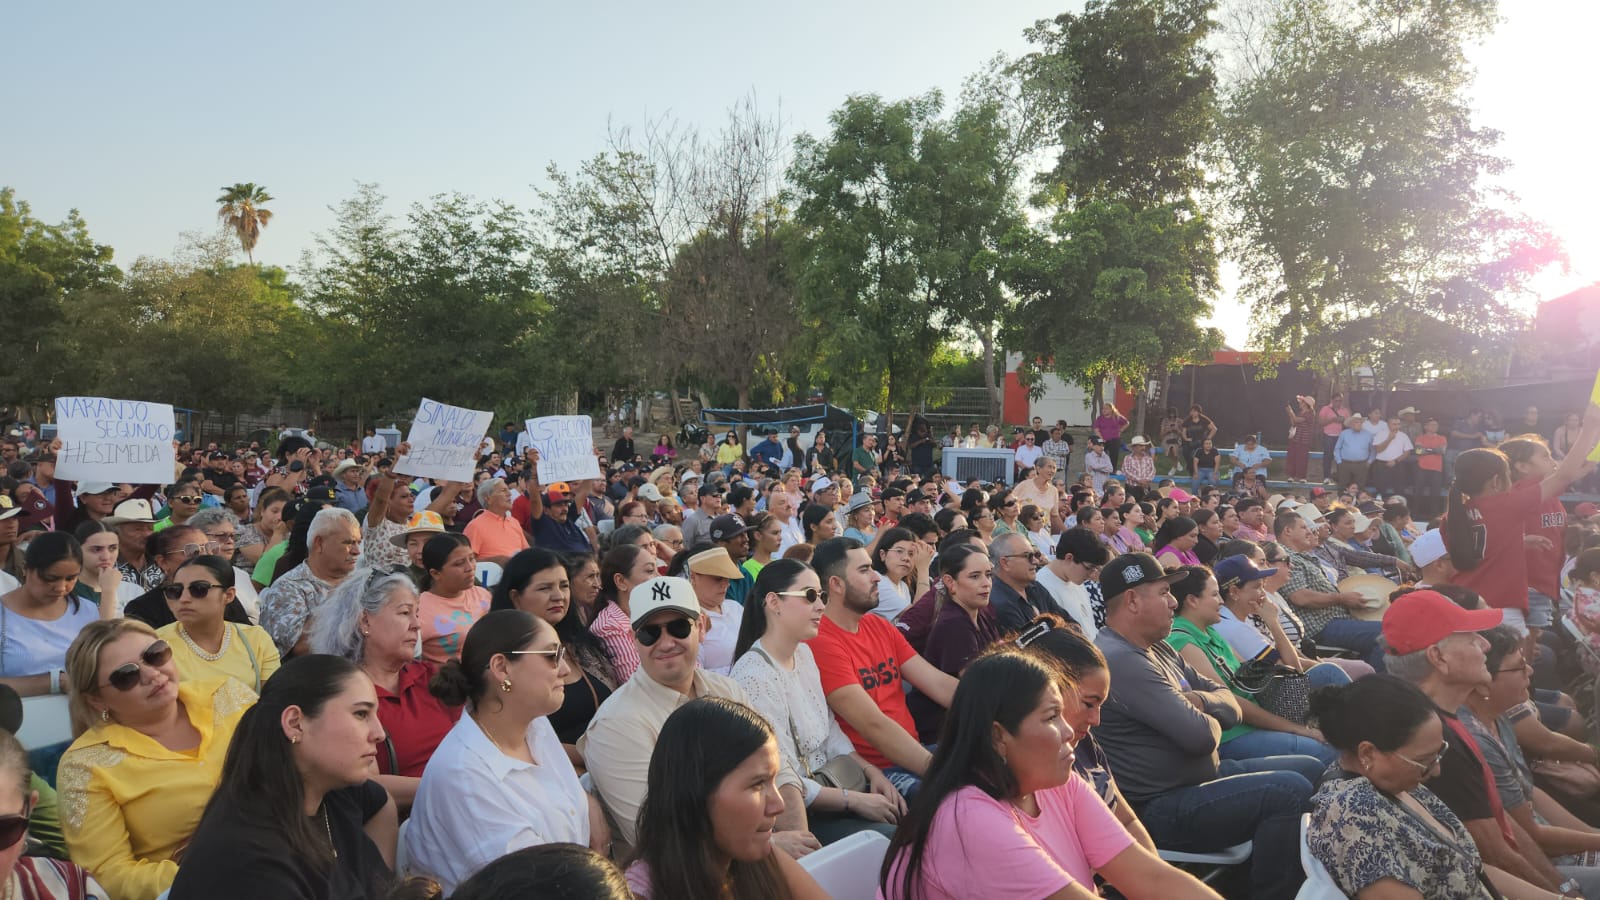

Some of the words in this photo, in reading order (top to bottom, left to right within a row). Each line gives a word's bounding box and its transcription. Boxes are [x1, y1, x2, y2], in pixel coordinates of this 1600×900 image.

[56, 398, 148, 421] NARANJO
[96, 420, 169, 442] SEGUNDO
[64, 440, 160, 464] #ESIMELDA
